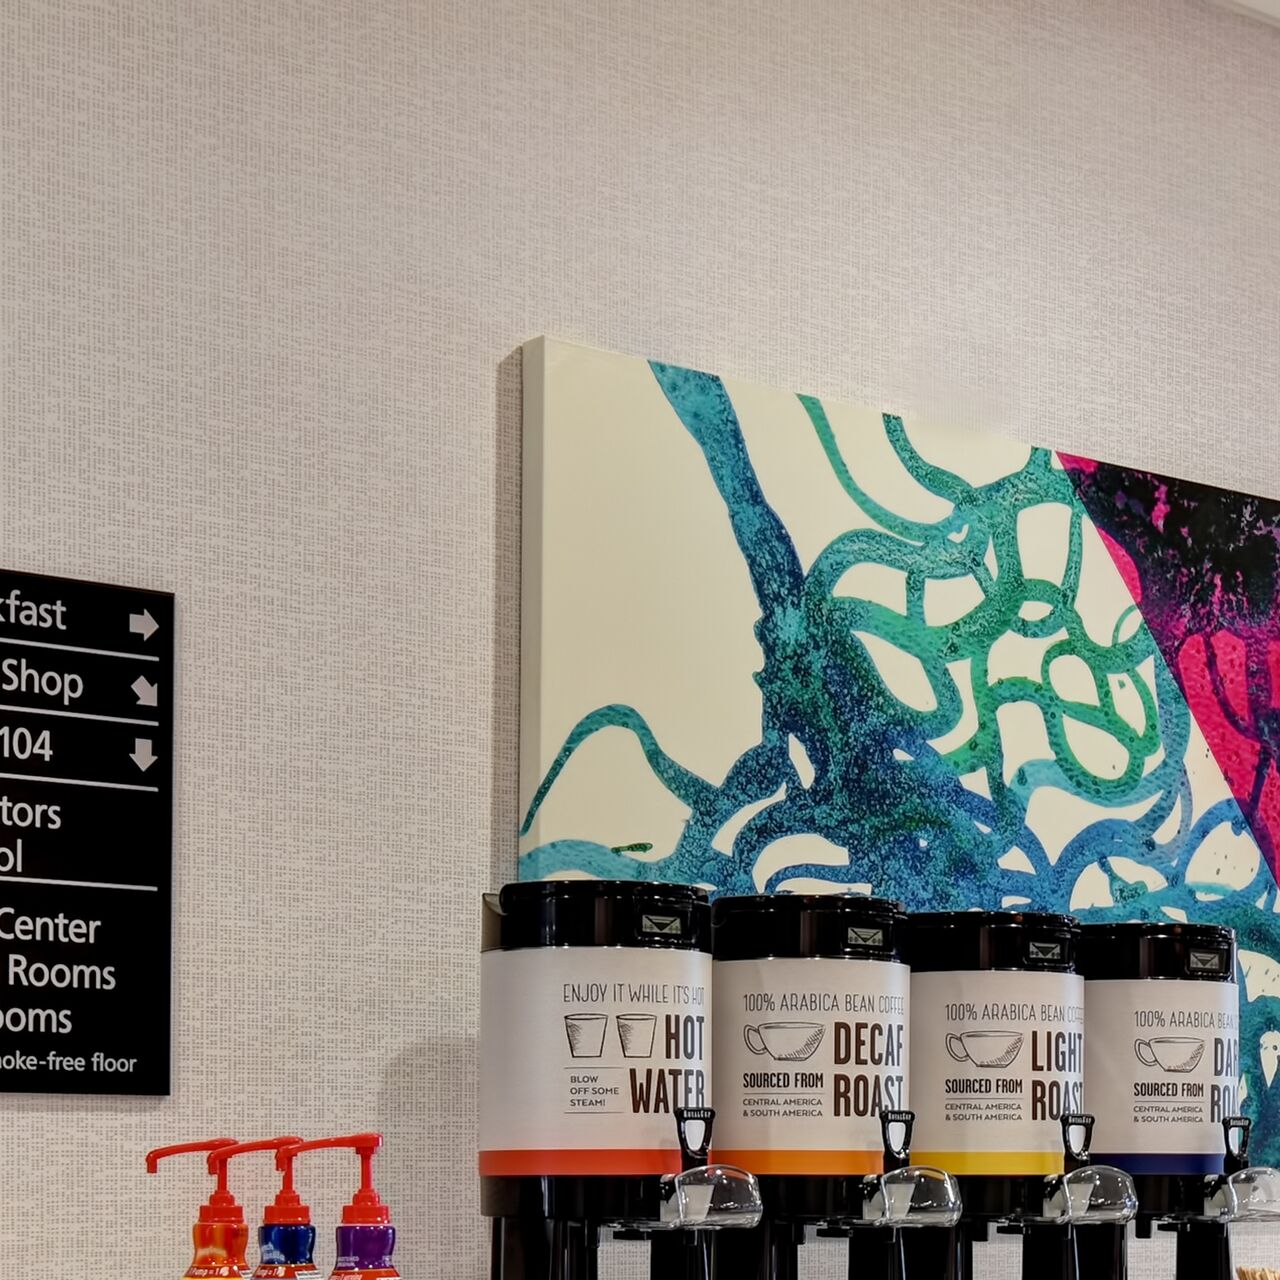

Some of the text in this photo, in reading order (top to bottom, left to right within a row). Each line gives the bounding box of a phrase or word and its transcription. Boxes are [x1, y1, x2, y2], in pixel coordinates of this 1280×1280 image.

[1, 657, 84, 705] Shop
[8, 955, 116, 990] Rooms
[563, 983, 608, 1003] ENJOY
[613, 984, 625, 1003] IT
[628, 984, 669, 1004] WHILE
[673, 985, 690, 1004] IT'S
[743, 993, 776, 1012] 100%
[780, 993, 840, 1013] ARABICA
[845, 994, 875, 1013] BEAN
[945, 1003, 978, 1021] 100%
[981, 1003, 1037, 1021] ARABICA
[1040, 1004, 1065, 1022] BEAN
[1134, 1010, 1166, 1028] 100%
[1169, 1011, 1216, 1029] ARABICA
[665, 1014, 705, 1060] HOT
[833, 1021, 904, 1066] DECAF
[1031, 1030, 1083, 1074] LIGHT
[91, 1052, 138, 1073] floor
[570, 1075, 599, 1084] BLOW
[742, 1072, 824, 1089] SOURCED FROM
[945, 1078, 1023, 1094] SOURCED FROM
[570, 1086, 620, 1096] OFF SOME
[629, 1067, 705, 1113] WATER
[833, 1073, 904, 1118] ROAST
[1133, 1082, 1204, 1098] SOURCED FROM
[570, 1098, 606, 1108] STEAM!
[742, 1098, 823, 1107] CENTRAL AMERICA
[944, 1103, 1023, 1111] CENTRAL AMERICA
[1031, 1079, 1083, 1121] ROAST
[1133, 1105, 1171, 1113] CENTRAL
[742, 1109, 823, 1118] & SOUTH AMERICA
[944, 1113, 1023, 1121] & SOUTH AMERICA
[1133, 1115, 1140, 1123] &
[1141, 1115, 1169, 1123] SOUTH
